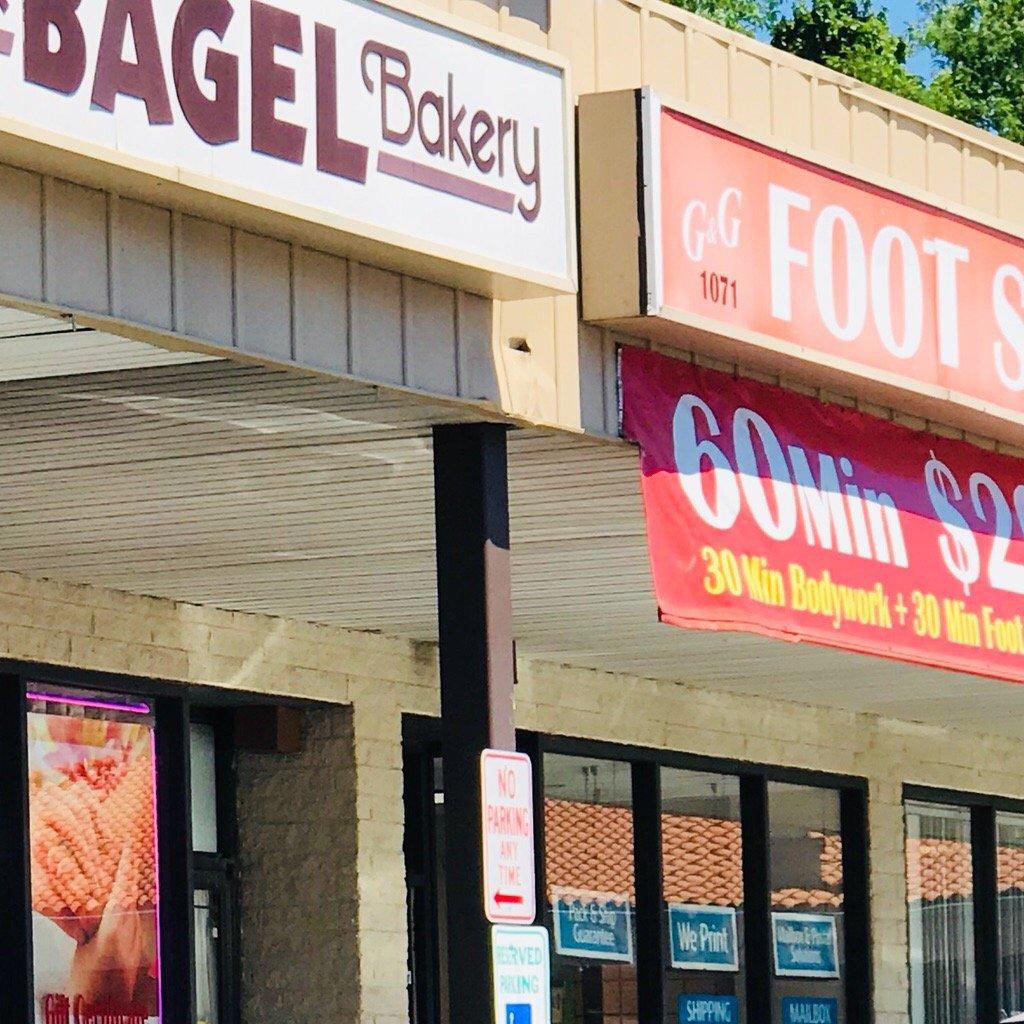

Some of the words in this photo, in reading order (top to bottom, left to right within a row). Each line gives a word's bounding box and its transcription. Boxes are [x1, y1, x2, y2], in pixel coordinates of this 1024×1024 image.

[23, 0, 369, 185] BAGEL
[361, 39, 541, 222] Bakery
[700, 270, 738, 308] 1071
[769, 183, 969, 368] FOOT
[701, 546, 742, 596] 30
[742, 556, 785, 606] Min
[789, 563, 892, 629] Bodywork
[912, 591, 940, 637] 30
[945, 601, 981, 647] Min
[497, 770, 516, 798] NO
[487, 805, 529, 836] PARKING
[500, 842, 519, 860] ANY
[499, 865, 521, 885] TIME
[677, 922, 698, 951] We
[700, 924, 728, 953] Print
[687, 1001, 731, 1022] SHIPPING
[789, 1003, 831, 1024] MAILBOX
